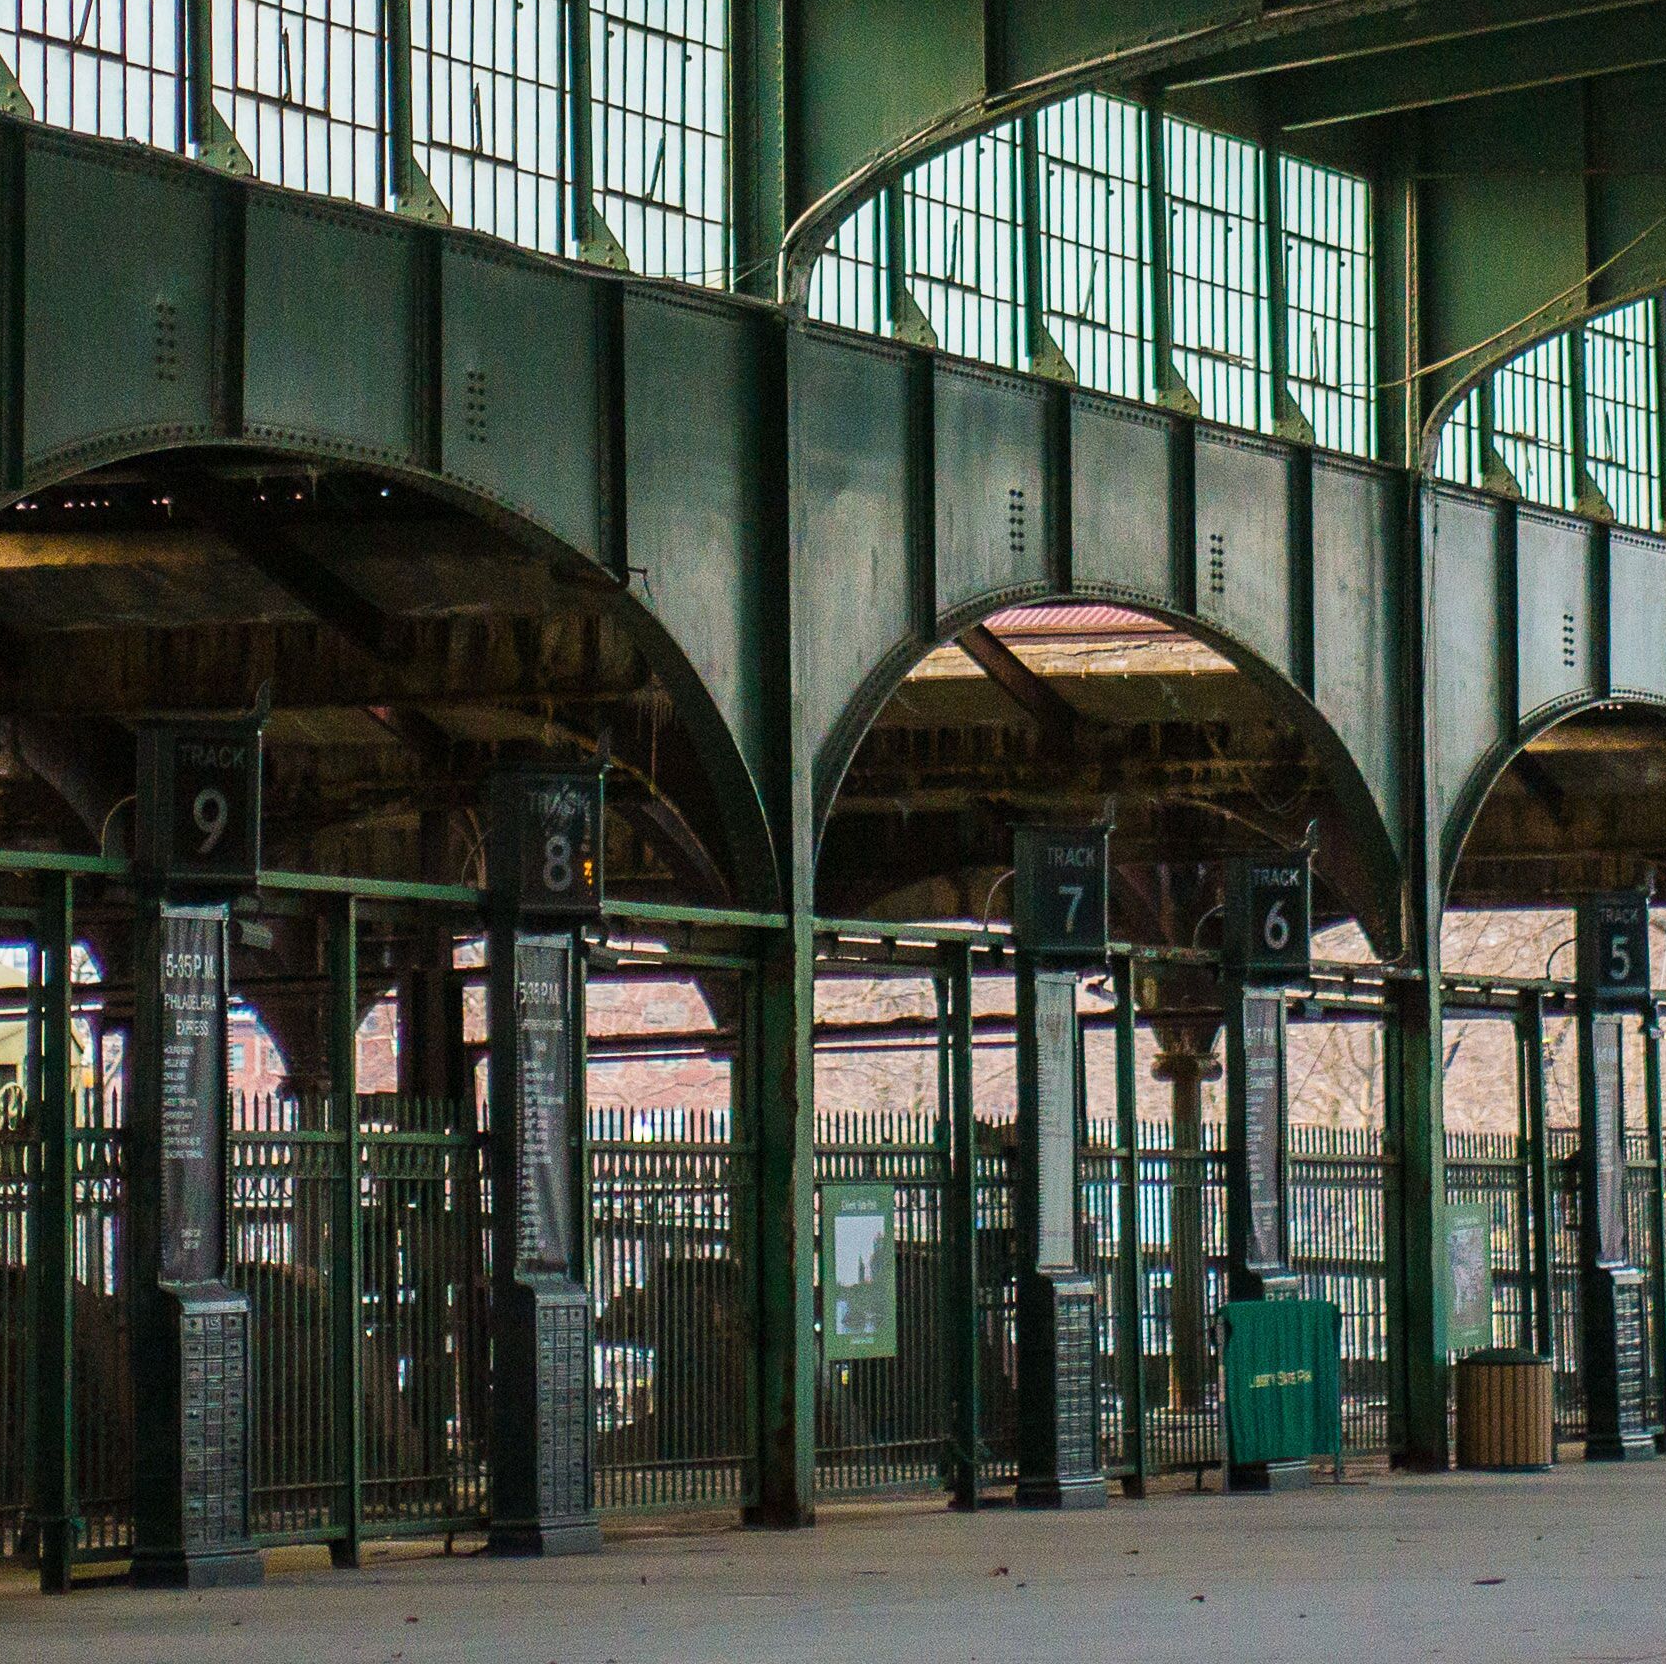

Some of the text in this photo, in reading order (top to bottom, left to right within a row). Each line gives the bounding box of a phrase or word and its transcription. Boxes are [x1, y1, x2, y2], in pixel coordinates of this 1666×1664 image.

[178, 744, 246, 769] TRACK
[193, 788, 228, 854] 9
[543, 835, 573, 891] 8
[1047, 847, 1095, 867] TRACK
[1252, 868, 1300, 886] TRACK
[1058, 885, 1083, 933] 7
[1264, 900, 1290, 949] 6
[1610, 936, 1630, 980] 5
[164, 993, 217, 1011] PHILADELPHIA
[175, 1019, 210, 1037] EXPRESS
